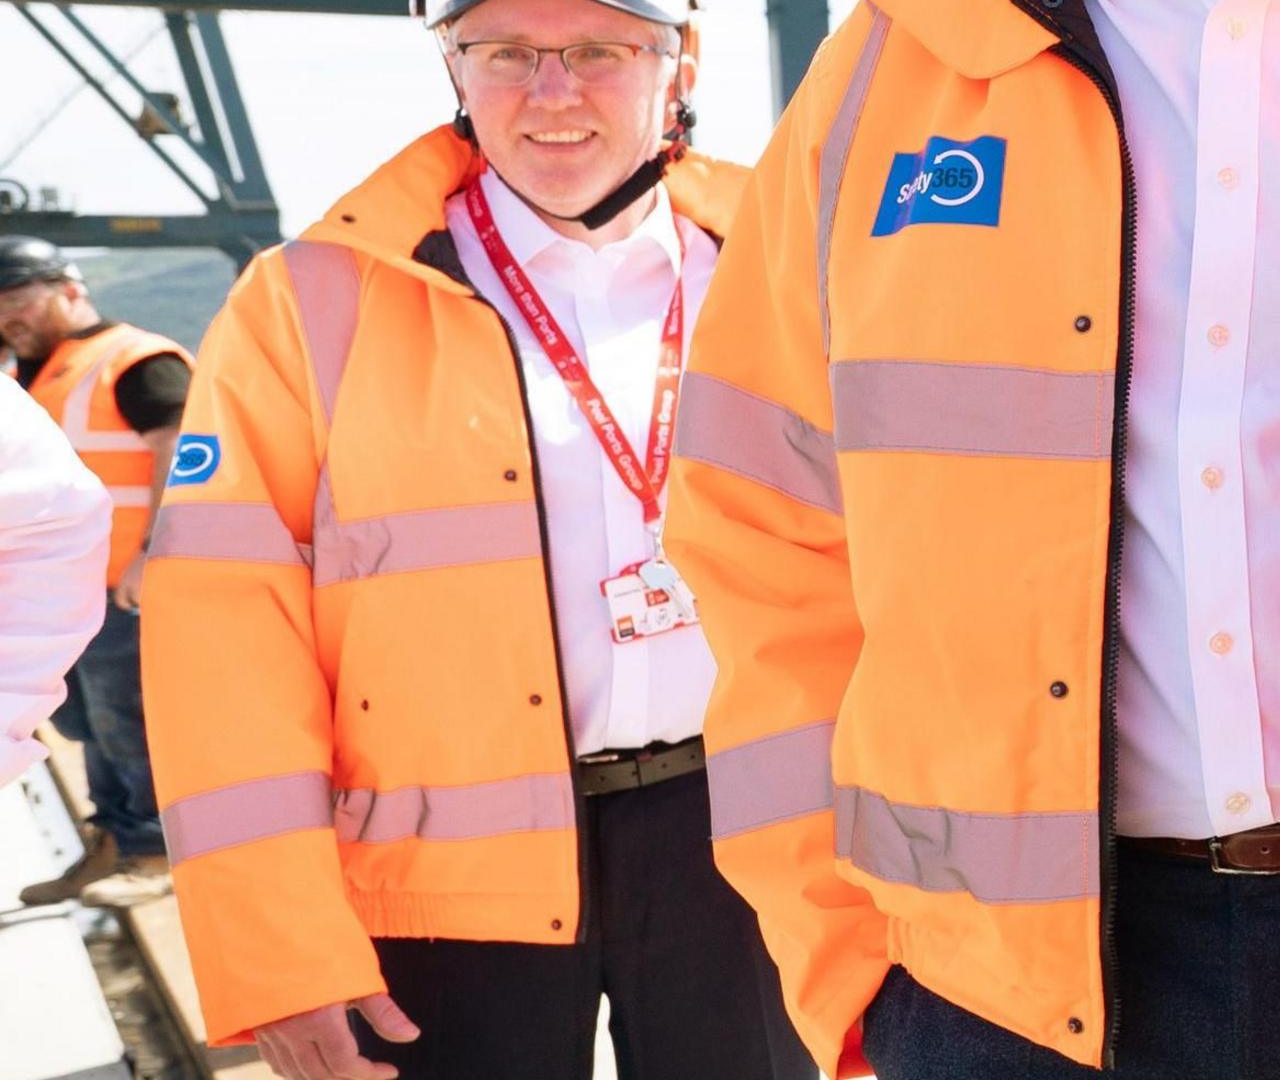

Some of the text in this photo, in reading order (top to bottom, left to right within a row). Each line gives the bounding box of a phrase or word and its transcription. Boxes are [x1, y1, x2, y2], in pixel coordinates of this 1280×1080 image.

[932, 168, 972, 188] 365
[503, 265, 558, 345] More than Ports
[587, 398, 643, 490] Peel Ports Group
